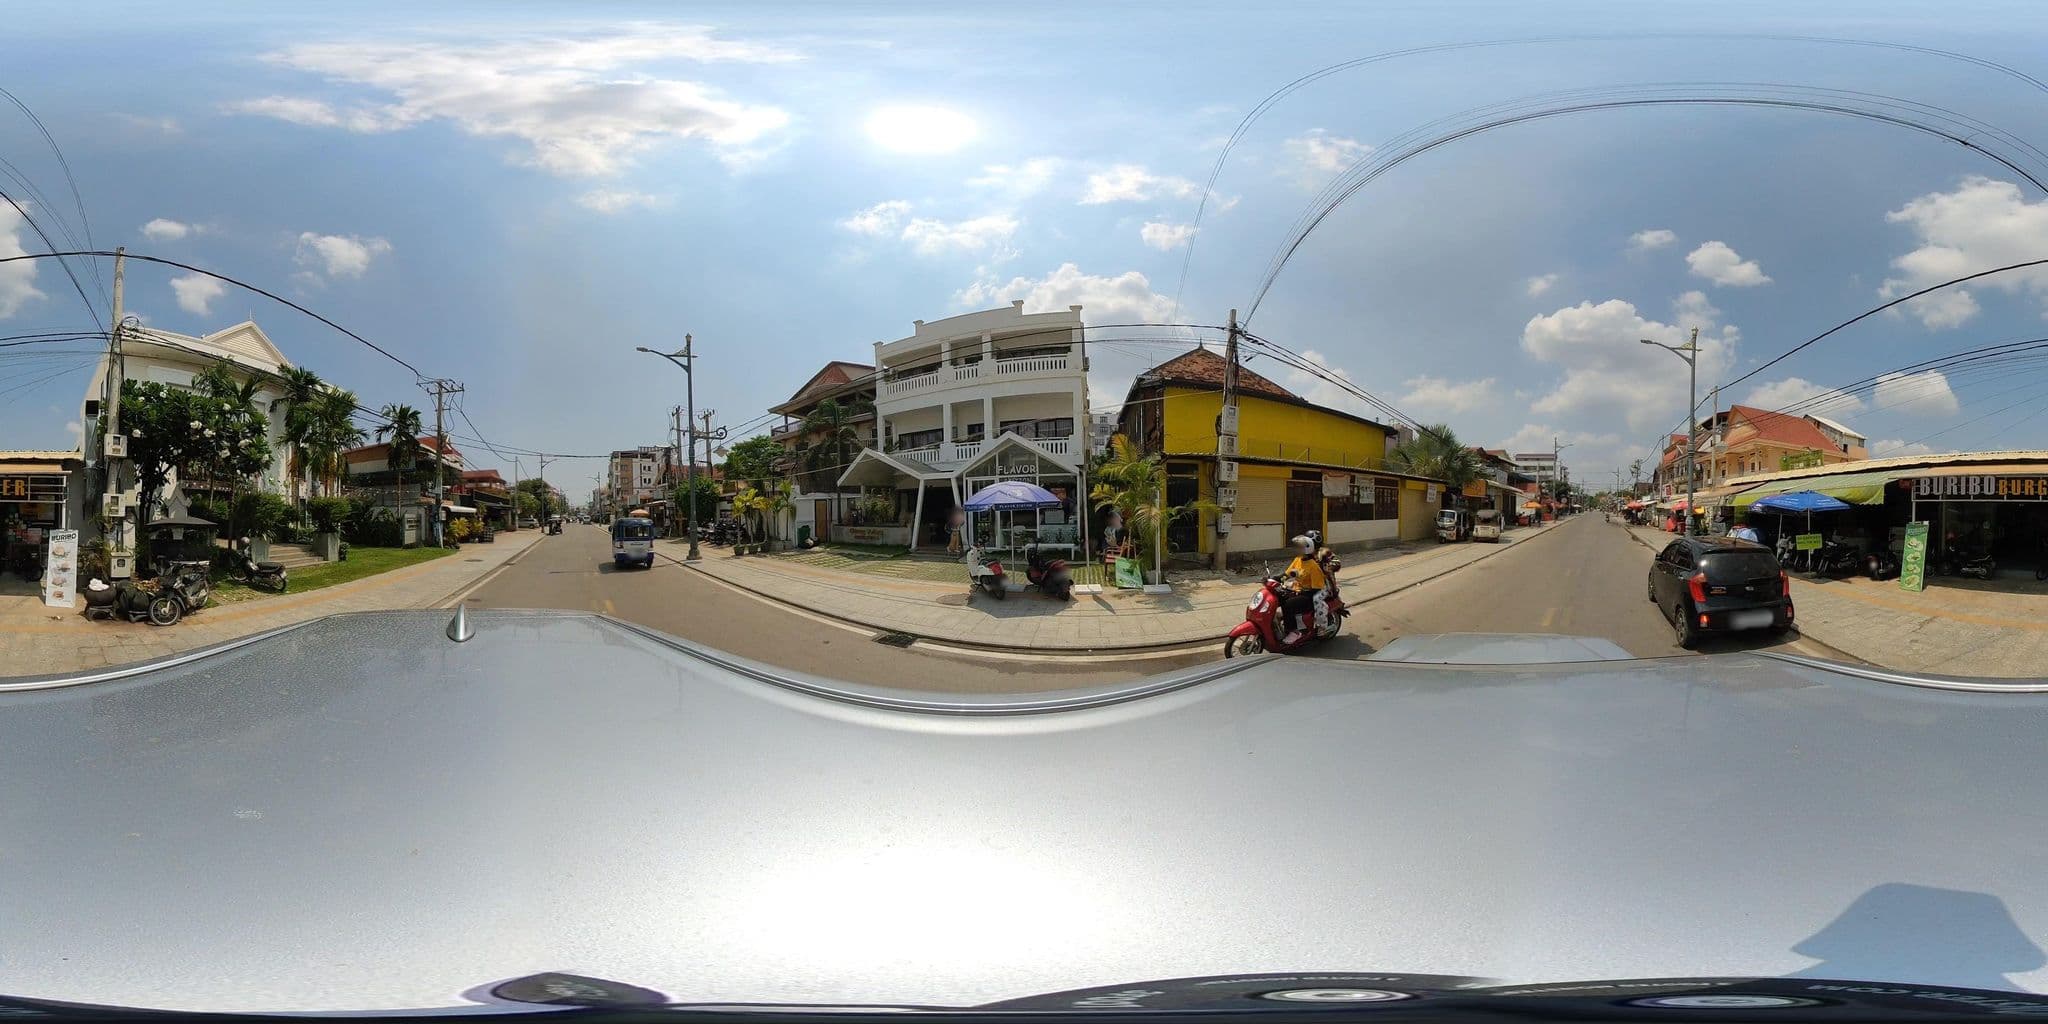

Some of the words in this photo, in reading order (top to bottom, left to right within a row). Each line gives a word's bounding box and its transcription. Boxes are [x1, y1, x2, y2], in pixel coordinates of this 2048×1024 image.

[997, 464, 1036, 475] FLAVOR
[2, 479, 25, 496] ER
[1920, 475, 1996, 496] BURIBO
